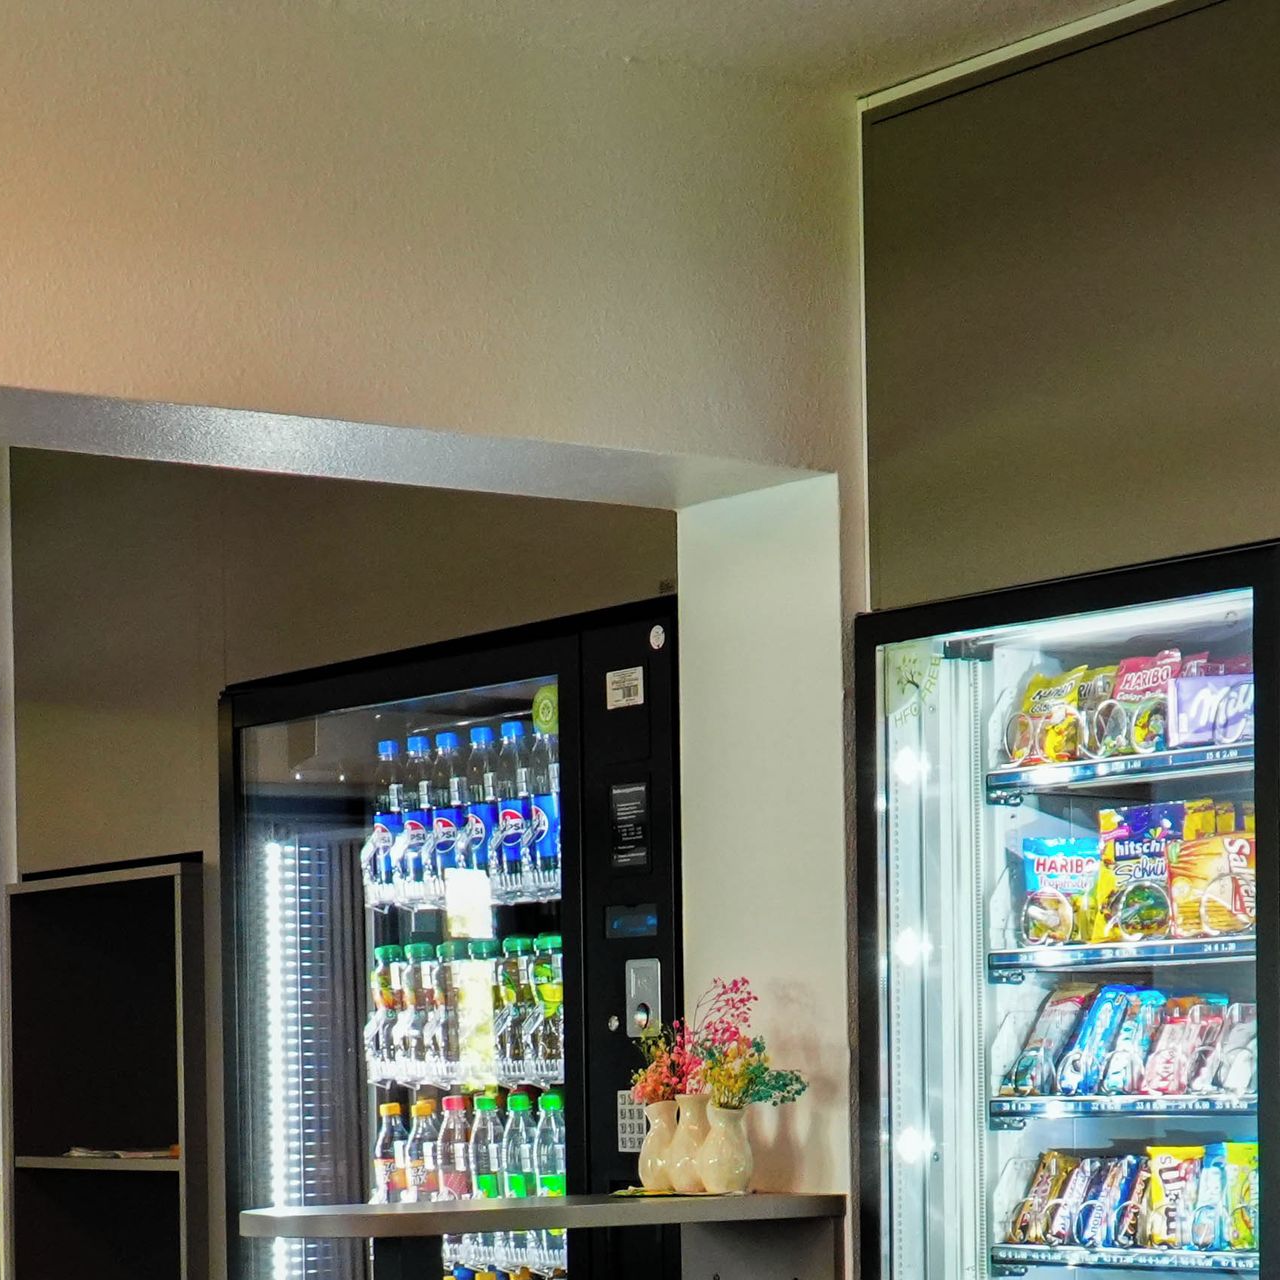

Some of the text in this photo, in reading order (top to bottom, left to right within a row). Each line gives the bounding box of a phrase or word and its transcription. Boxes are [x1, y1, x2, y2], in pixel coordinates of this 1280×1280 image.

[1122, 665, 1173, 691] HARIBO
[1115, 839, 1167, 858] hitschi
[1035, 857, 1095, 874] HARIBO
